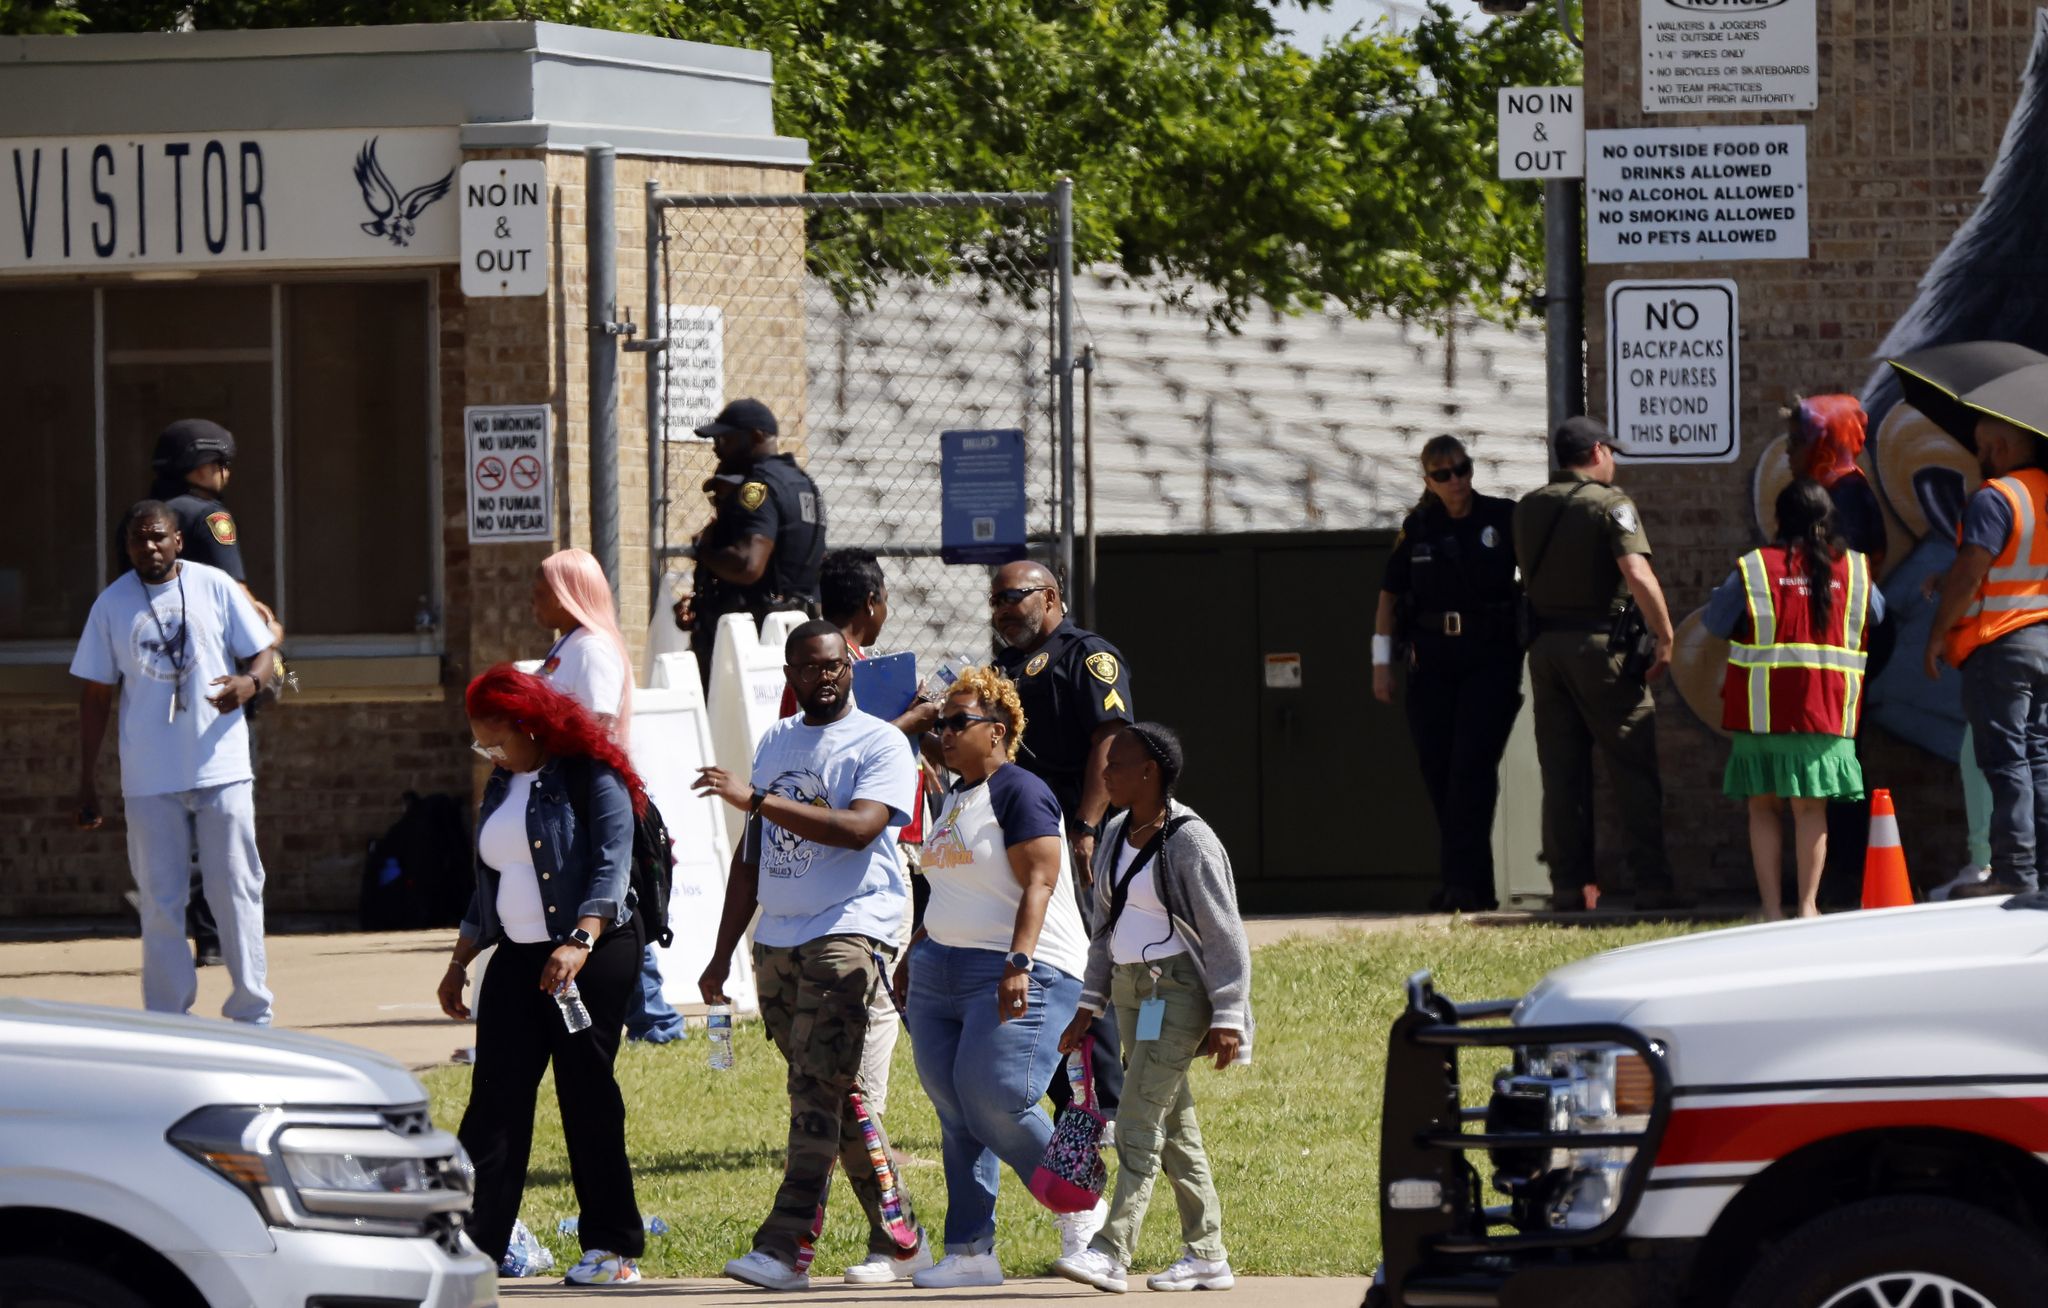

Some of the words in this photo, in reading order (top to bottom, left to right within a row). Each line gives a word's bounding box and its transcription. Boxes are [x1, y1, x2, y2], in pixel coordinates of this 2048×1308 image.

[1657, 22, 1704, 31] WALKERS
[1709, 22, 1715, 30] &
[1720, 20, 1767, 30] JOGGERS
[1657, 33, 1677, 42] USE
[1681, 32, 1723, 42] OUTSIDE
[1727, 31, 1760, 41] LANES
[1682, 50, 1717, 59] SPIKES
[1721, 49, 1745, 58] ONLY
[1657, 67, 1671, 76] NO
[1674, 67, 1720, 76] BICYCLES
[1724, 66, 1738, 75] OR
[1741, 65, 1809, 75] SKATEBOARDS
[1658, 84, 1672, 93] NO
[1676, 84, 1703, 92] TEAM
[1707, 83, 1762, 92] PRACTICES
[1508, 94, 1543, 114] NO
[1551, 93, 1572, 113] IN
[1658, 95, 1703, 104] WITHOUT
[1707, 94, 1738, 104] PRIOR
[1740, 93, 1796, 103] AUTHORITY
[1533, 122, 1548, 142] &
[1602, 146, 1627, 159] NO
[1634, 144, 1708, 158] OUTSIDE
[1713, 143, 1760, 156] FOOD
[1766, 142, 1788, 155] OR
[1515, 150, 1567, 171] OUT
[1621, 166, 1685, 180] DRINKS
[1691, 164, 1771, 179] ALLOWED
[13, 140, 266, 259] VISITOR
[468, 184, 507, 207] NO
[514, 183, 538, 206] IN
[1599, 188, 1623, 202] NO
[1628, 187, 1708, 201] ALCOHOL
[1714, 185, 1794, 200] ALLOWED
[1599, 210, 1623, 224] NO
[1629, 209, 1709, 223] SMOKING
[1715, 207, 1795, 221] ALLOWED
[494, 216, 512, 238] &
[1618, 232, 1642, 245] NO
[1648, 230, 1690, 244] PETS
[1696, 229, 1776, 243] ALLOWED
[476, 249, 532, 272] OUT
[1646, 302, 1699, 330] NO
[1622, 340, 1724, 360] BACKPACKS
[1630, 369, 1654, 387] OR
[1660, 367, 1717, 387] PURSES
[1639, 397, 1708, 415] BEYOND
[474, 418, 488, 432] NO
[493, 416, 542, 431] SMOKING
[1630, 424, 1663, 442] THIS
[1669, 423, 1718, 442] POINT
[479, 437, 493, 450] NO
[497, 435, 537, 449] VAPING
[478, 497, 495, 511] NO
[499, 495, 542, 511] FUMAR
[476, 516, 493, 530] NO
[497, 515, 544, 530] VAPEAR
[1088, 653, 1114, 666] POLICE
